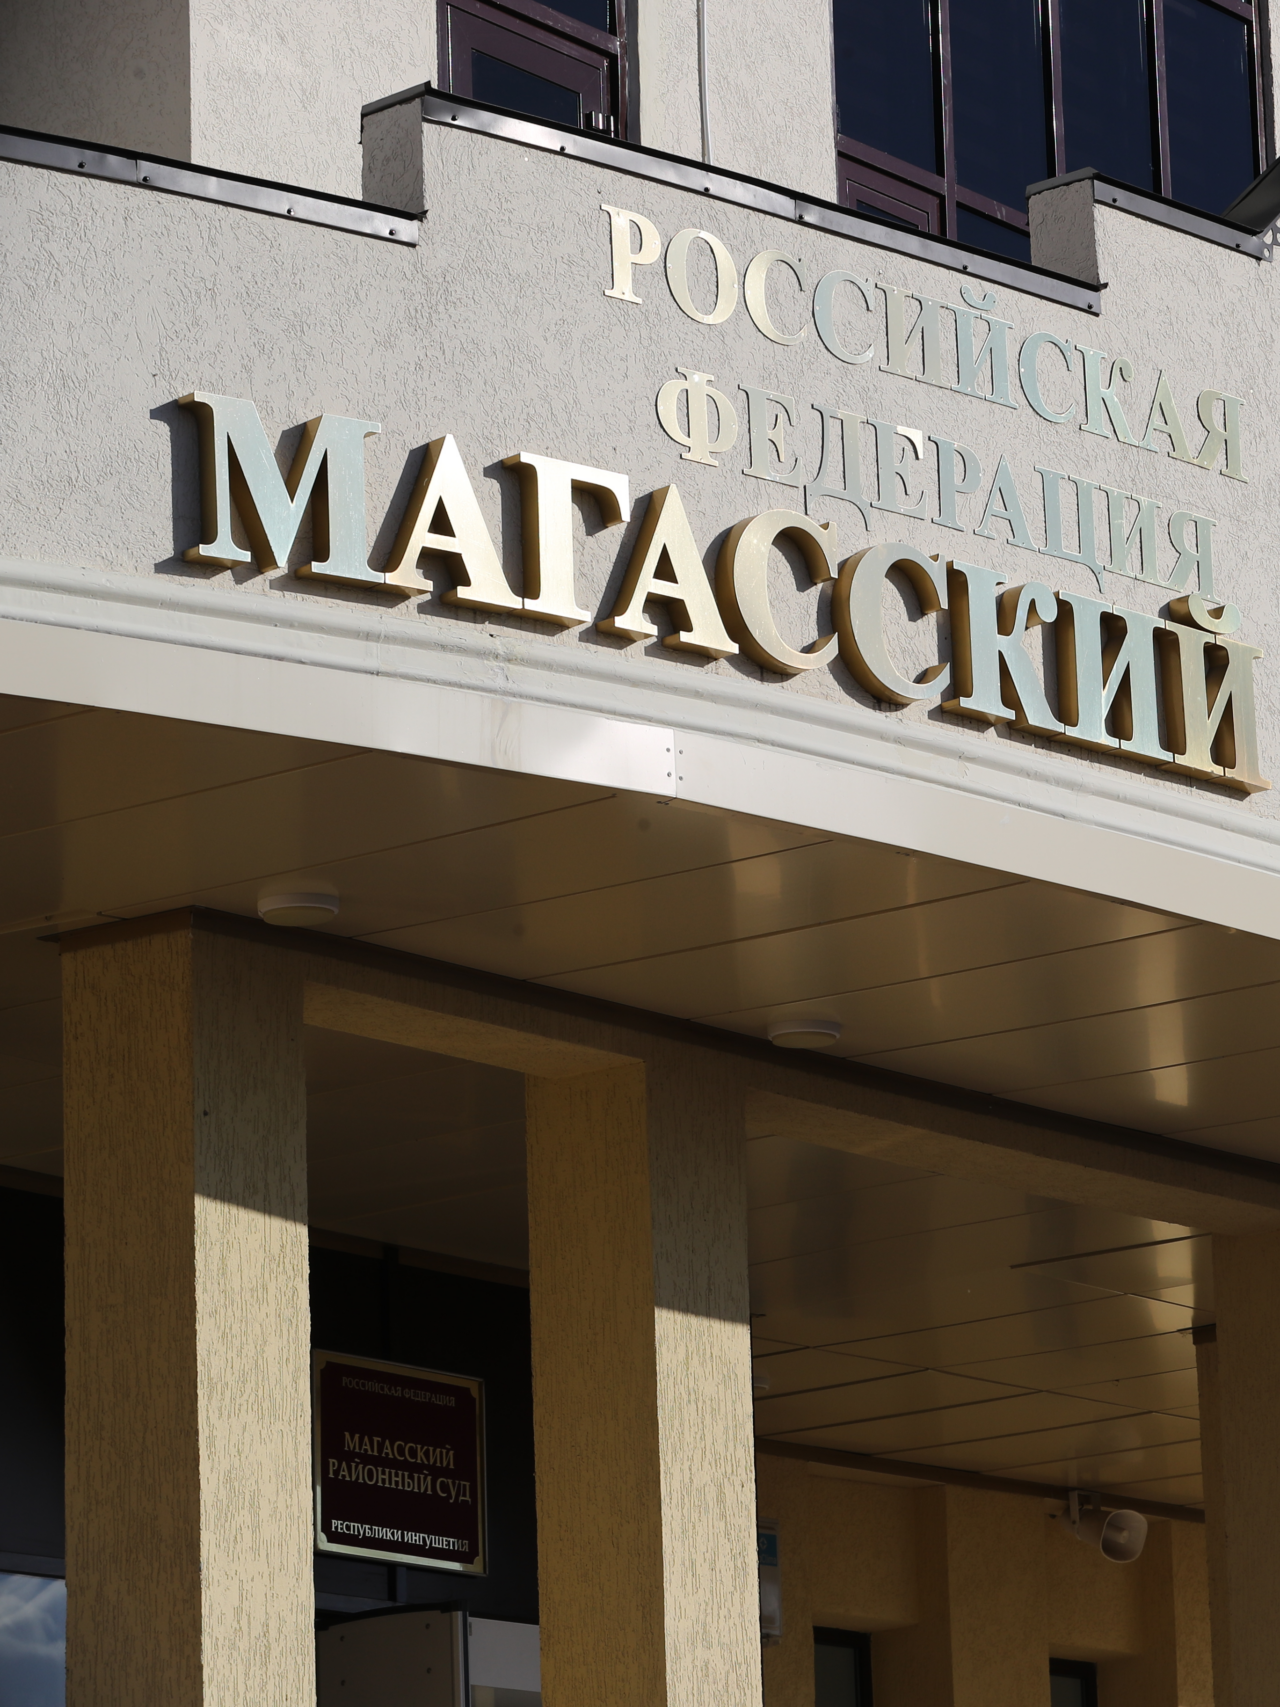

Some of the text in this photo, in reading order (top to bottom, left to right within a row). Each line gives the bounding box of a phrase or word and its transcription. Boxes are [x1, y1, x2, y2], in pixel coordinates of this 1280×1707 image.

[599, 203, 1250, 483] РОССИЙСКАЯ
[655, 366, 1219, 602] ФЕДЕРАЦИЯ
[178, 391, 1270, 794] МАГАССКИЙ
[342, 1377, 456, 1407] РОССИЙСКАЯ ФЕДЕРАЦИЯ
[344, 1432, 455, 1469] МАГАССКИЙ
[328, 1458, 472, 1505] РАЙОННЫЙ СУД
[331, 1519, 469, 1552] РЕСПУБЛИКИ ИНГУШЕТИЯ
